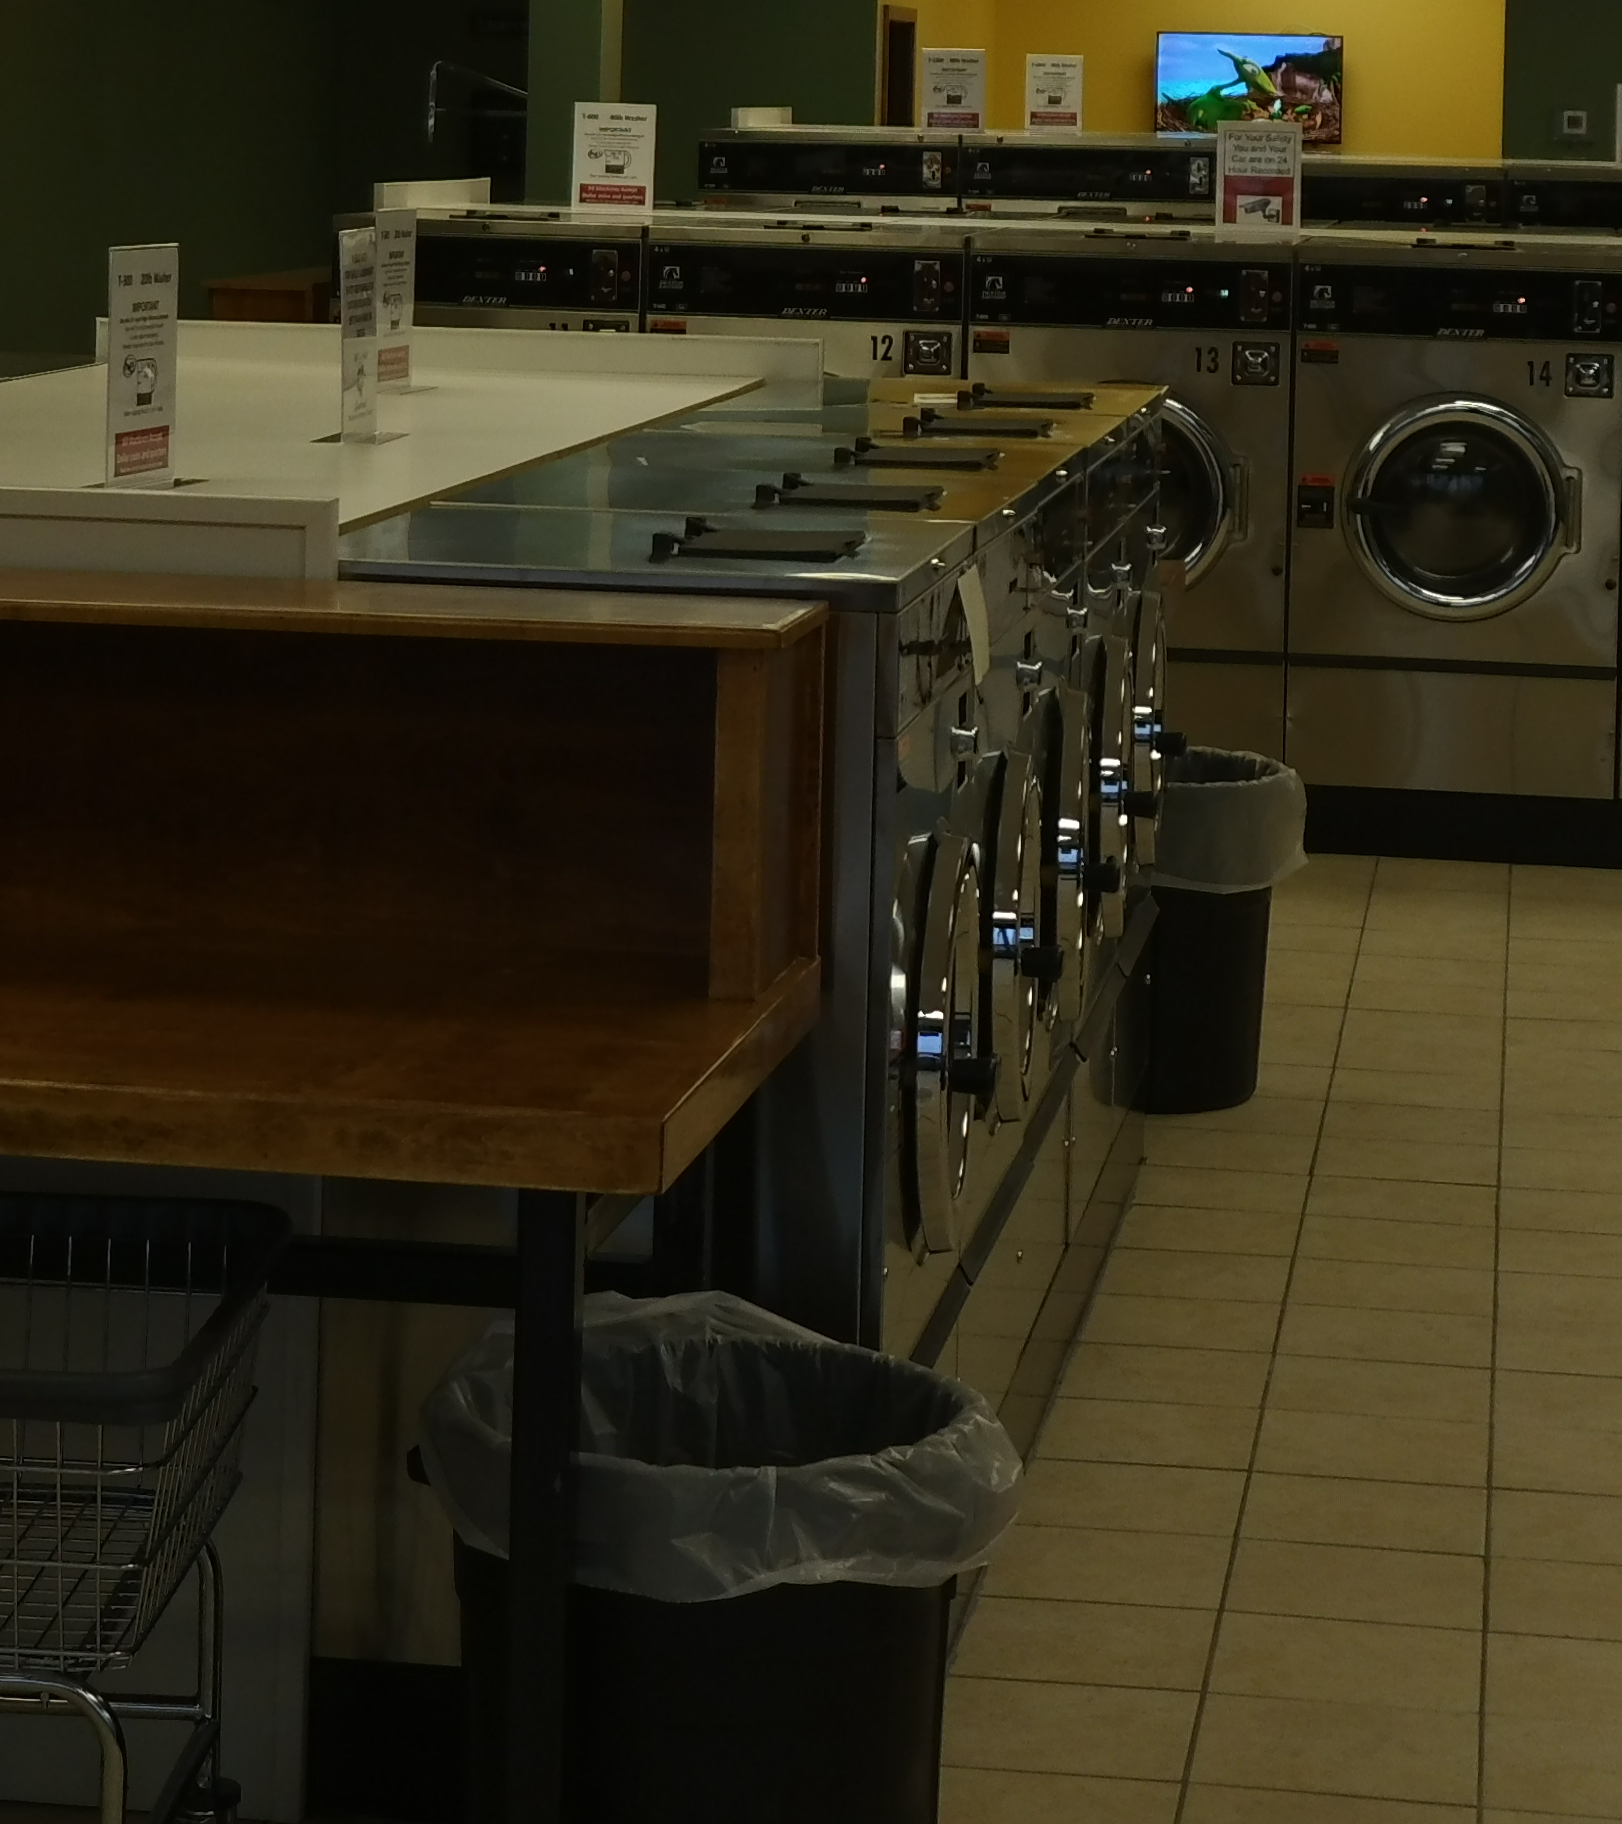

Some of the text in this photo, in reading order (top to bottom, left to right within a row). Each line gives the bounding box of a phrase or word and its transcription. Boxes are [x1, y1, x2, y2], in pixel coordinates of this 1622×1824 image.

[1228, 133, 1292, 144] For Your Safety
[1233, 144, 1248, 152] You
[1269, 145, 1287, 153] Your
[1231, 155, 1247, 163] Car
[1277, 156, 1288, 164] 24
[1228, 166, 1291, 175] Hour Recorded
[462, 295, 508, 305] DEXTER
[781, 306, 829, 317] DEXTER
[1106, 317, 1154, 327] DEXTER
[1436, 327, 1486, 338] DEXTER
[870, 335, 894, 362] 12
[1195, 346, 1220, 374] 13
[1527, 360, 1553, 387] 14
